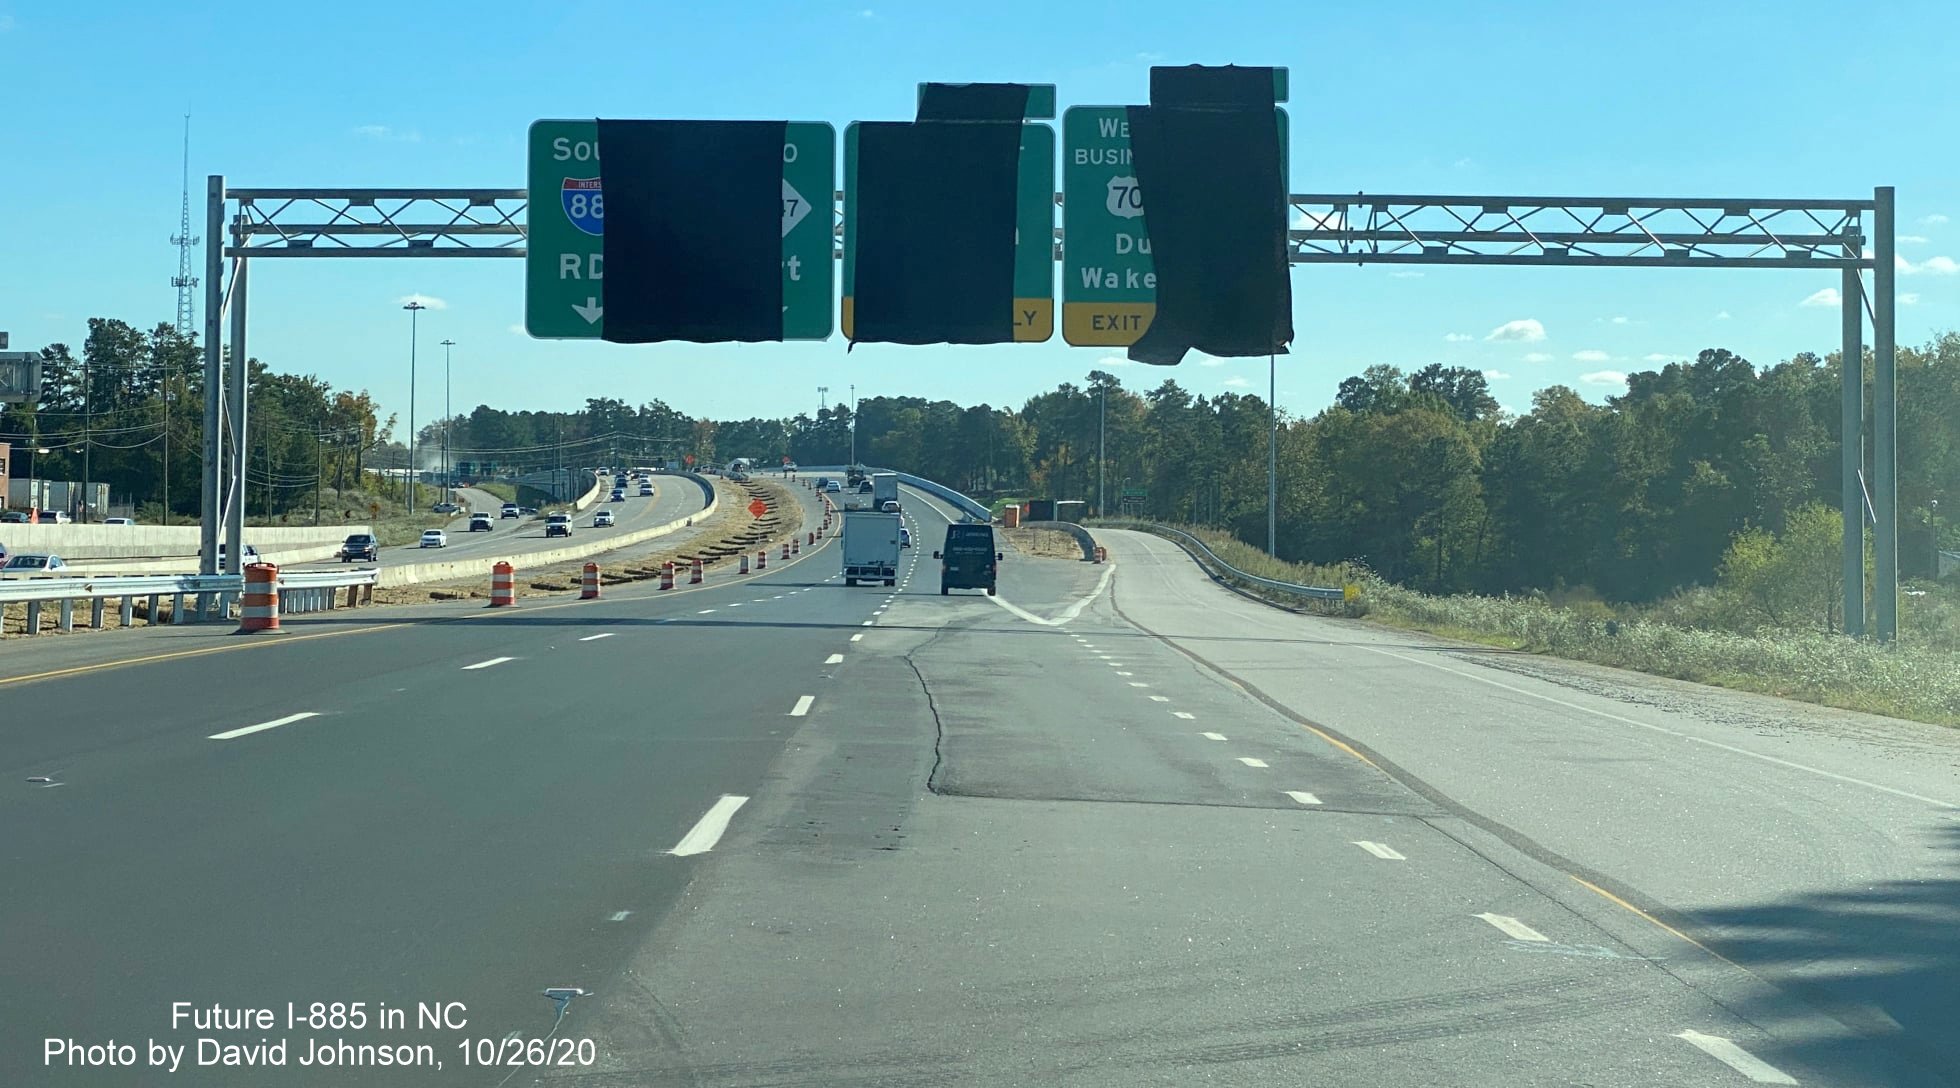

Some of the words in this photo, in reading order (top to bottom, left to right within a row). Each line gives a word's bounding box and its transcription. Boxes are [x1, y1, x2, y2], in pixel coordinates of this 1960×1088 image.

[1112, 186, 1143, 209] 70
[782, 199, 799, 217] 7
[1081, 267, 1157, 289] Wake
[1092, 315, 1142, 331] EXIT
